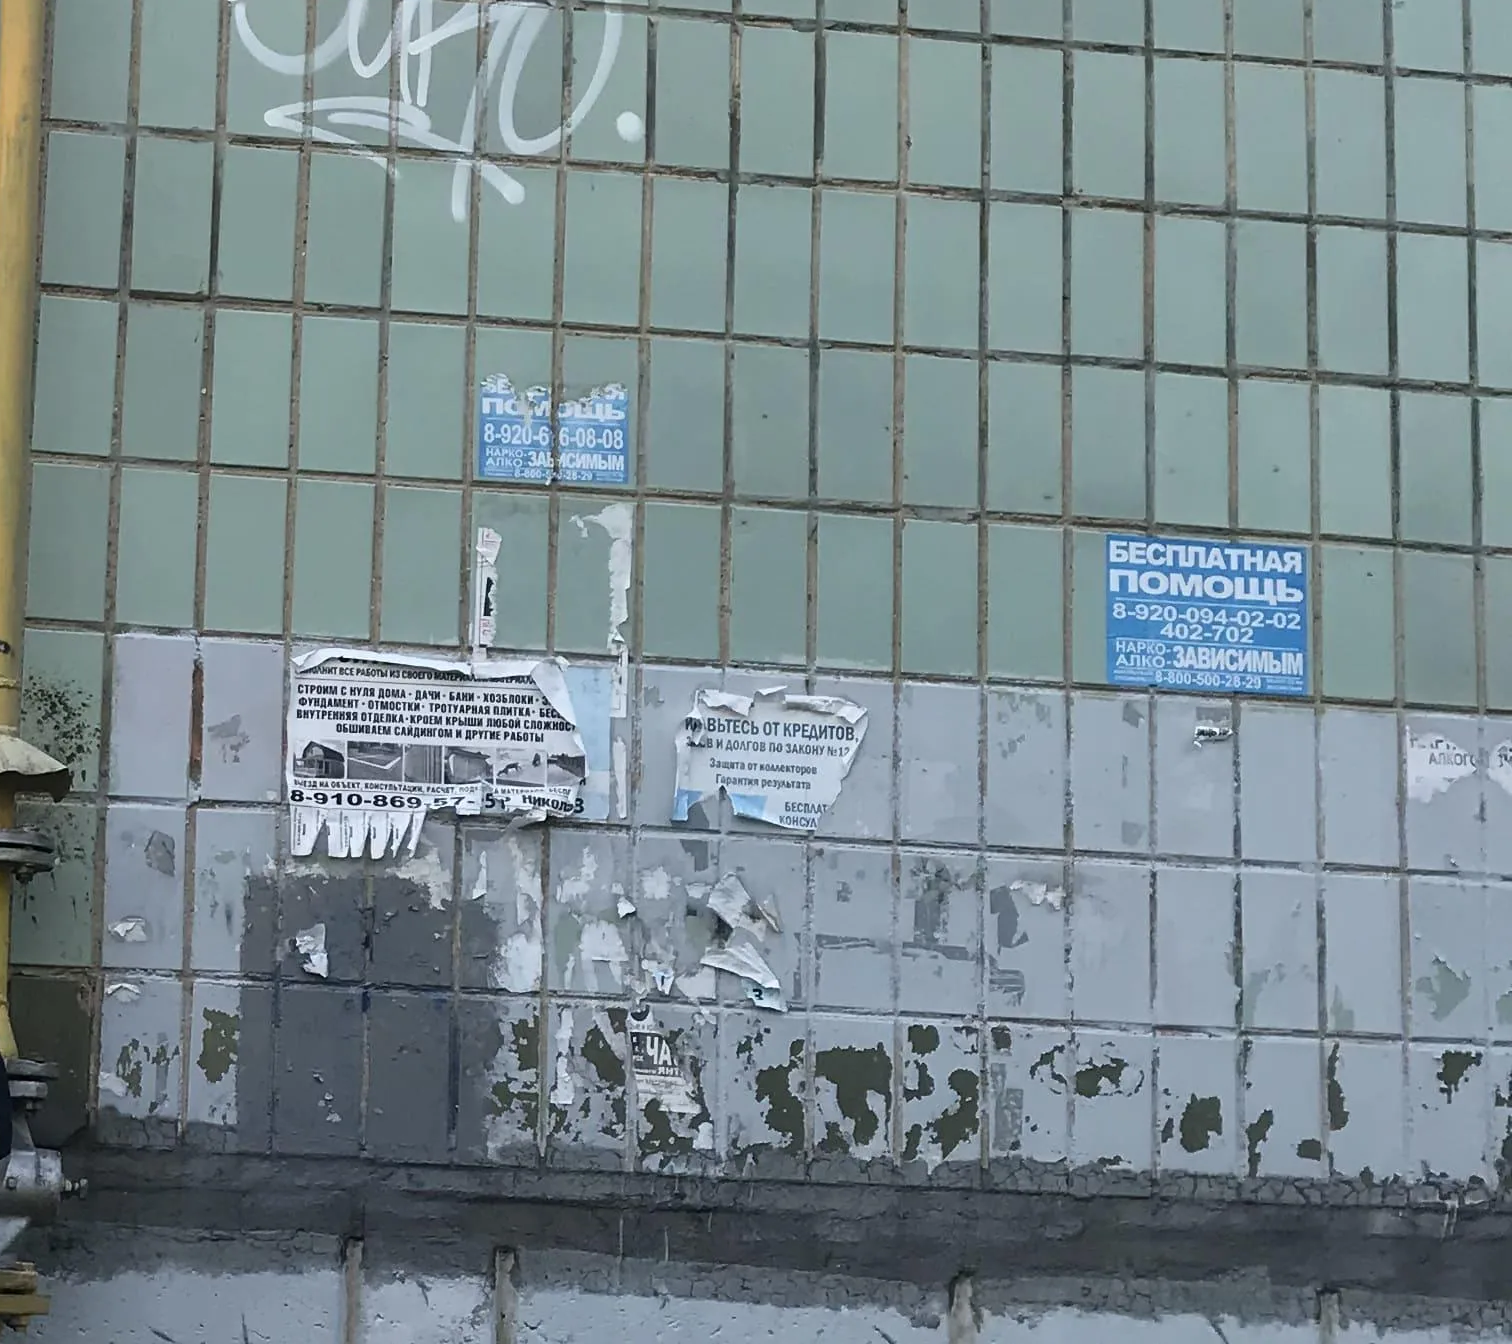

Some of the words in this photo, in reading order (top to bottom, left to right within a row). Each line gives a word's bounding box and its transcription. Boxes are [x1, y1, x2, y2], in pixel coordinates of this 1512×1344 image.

[484, 423, 624, 449] 8-920-66-08-08
[1109, 540, 1303, 574] БЕСПЛАТНАЯ
[1109, 568, 1304, 605] ПОМОЩЬ
[1112, 602, 1301, 630] 8-920-094-02-02
[1160, 622, 1255, 644] 402-702
[1116, 640, 1172, 656] НАРКО-
[1116, 653, 1172, 669] АЛКО-
[1173, 645, 1304, 676] ЗАВИСИМЫМ
[339, 666, 354, 677] ВСЕ
[356, 666, 388, 678] РАБОТЫ
[390, 668, 401, 679] ИЗ
[402, 669, 432, 681] СВОЕГО
[297, 684, 337, 696] СТРОИМ
[341, 686, 347, 696] С
[350, 686, 375, 698] НУЛЯ
[378, 688, 406, 699] ДОМА
[415, 690, 440, 701] ДАЧИ
[449, 691, 474, 702] БАНИ
[483, 693, 533, 705] ХОЗБЛОКИ
[298, 697, 359, 709] ФУНДАМЕНТ
[367, 700, 420, 712] ОТМОСТКИ
[429, 702, 490, 715] ТРОТУАРНАЯ
[493, 706, 530, 717] ПЛИТКА
[296, 709, 358, 721] ВНУТРЕННЯЯ
[360, 712, 406, 724] ОТДЕЛКА
[409, 714, 442, 725] КРОЕМ
[445, 716, 483, 727] КРЫШИ
[486, 716, 521, 729] ЛЮБОЙ
[336, 723, 391, 736] ОБШИВАЕМ
[394, 724, 453, 739] САЙДИНГОМ
[456, 730, 462, 739] И
[465, 730, 501, 741] ДРУГИЕ
[503, 731, 544, 743] РАБОТЫ
[763, 721, 780, 737] ОТ
[783, 722, 859, 743] КРЕДИТОВ,
[716, 738, 723, 749] И
[725, 739, 766, 752] ДОЛГОВ
[769, 742, 783, 753] ПО
[785, 743, 825, 756] ЗАКОНУ
[709, 757, 745, 770] Защита
[748, 762, 757, 771] от
[759, 763, 817, 775] коллекторов
[319, 780, 329, 788] НА
[716, 773, 759, 786] Гарантия
[761, 778, 811, 790] результата
